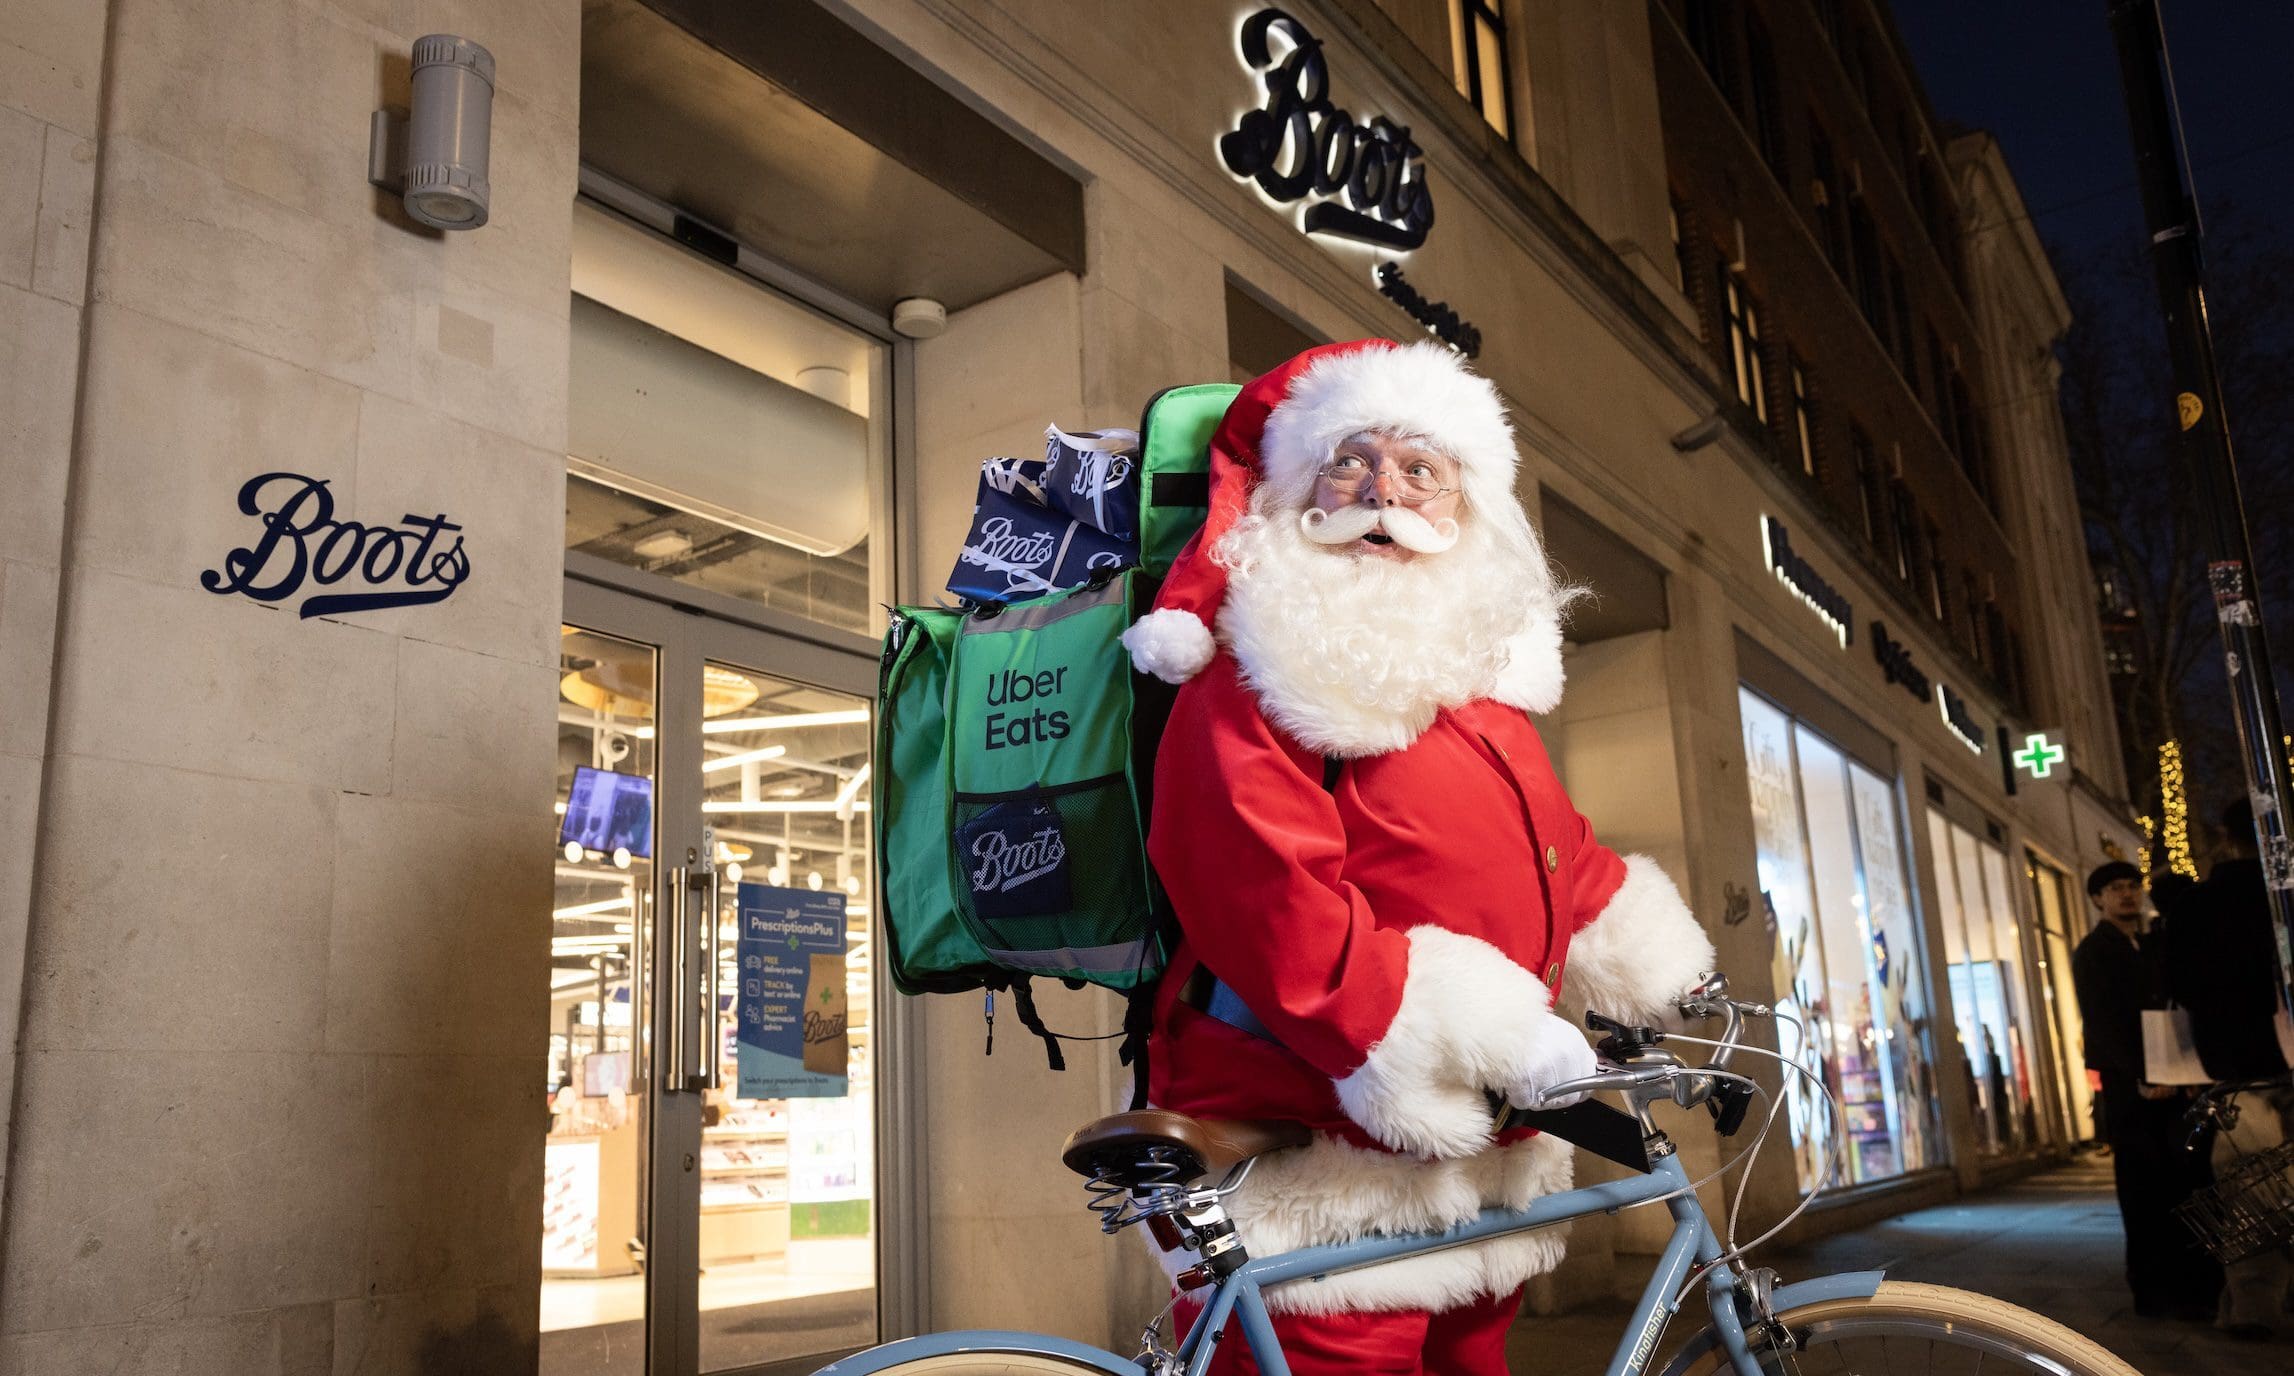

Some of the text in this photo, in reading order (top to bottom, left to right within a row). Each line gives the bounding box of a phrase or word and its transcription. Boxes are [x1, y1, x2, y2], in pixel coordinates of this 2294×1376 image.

[1220, 8, 1434, 251] Boots
[200, 472, 470, 620] Boots
[961, 516, 1055, 572] Boots
[987, 666, 1068, 706] Uber
[985, 708, 1071, 750] Eats
[972, 826, 1065, 892] Boots
[751, 916, 834, 937] PrescriptionsPlus
[763, 955, 779, 965] FREE
[763, 965, 803, 975] delivery online
[763, 980, 785, 989] TRACK
[763, 1005, 787, 1013] EXPERT
[763, 1014, 796, 1023] Pharmacist
[763, 1023, 783, 1032] advice
[804, 1010, 845, 1045] Boots
[1629, 1301, 1667, 1371] Kingfisher
